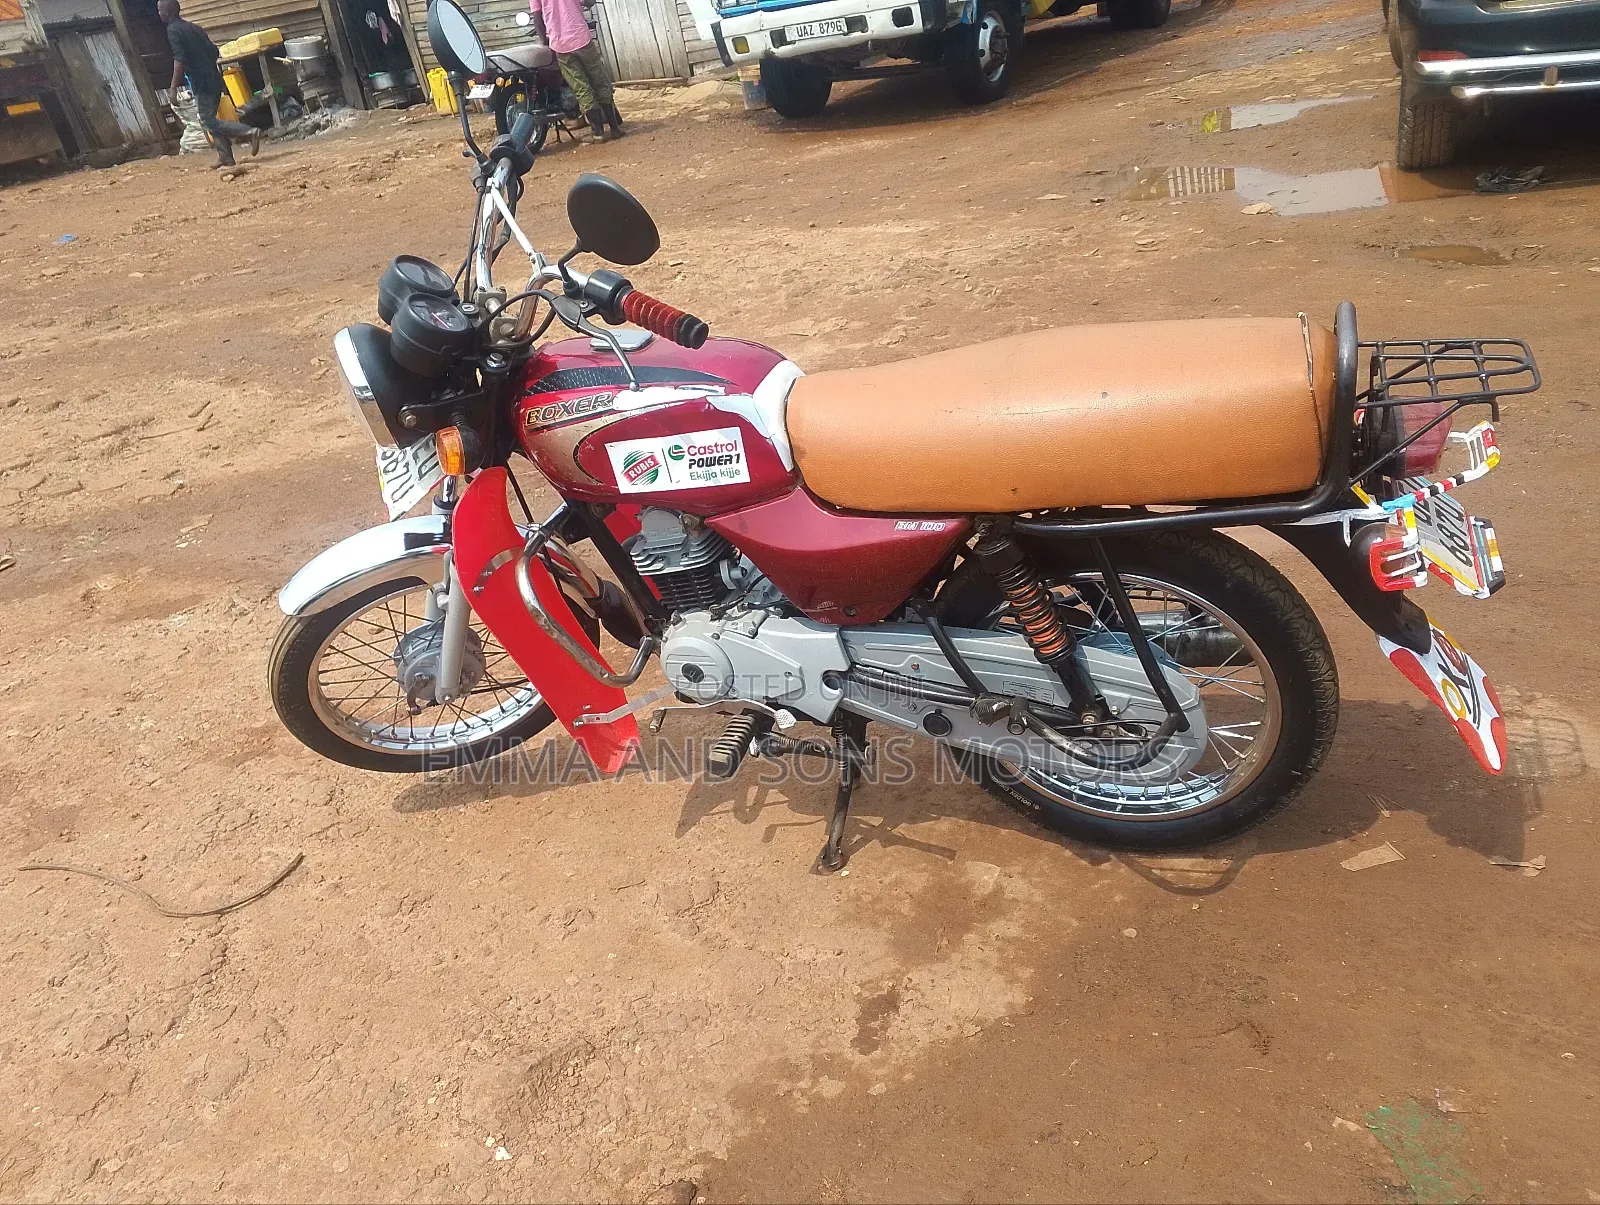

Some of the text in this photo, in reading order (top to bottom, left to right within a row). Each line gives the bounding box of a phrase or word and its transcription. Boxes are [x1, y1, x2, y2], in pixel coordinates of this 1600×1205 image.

[796, 25, 815, 37] UAZ
[525, 391, 614, 425] BOXER
[687, 440, 738, 457] Castrol
[628, 459, 656, 480] RUBIS
[689, 467, 741, 481] Ekijja kijje
[920, 521, 946, 532] 100
